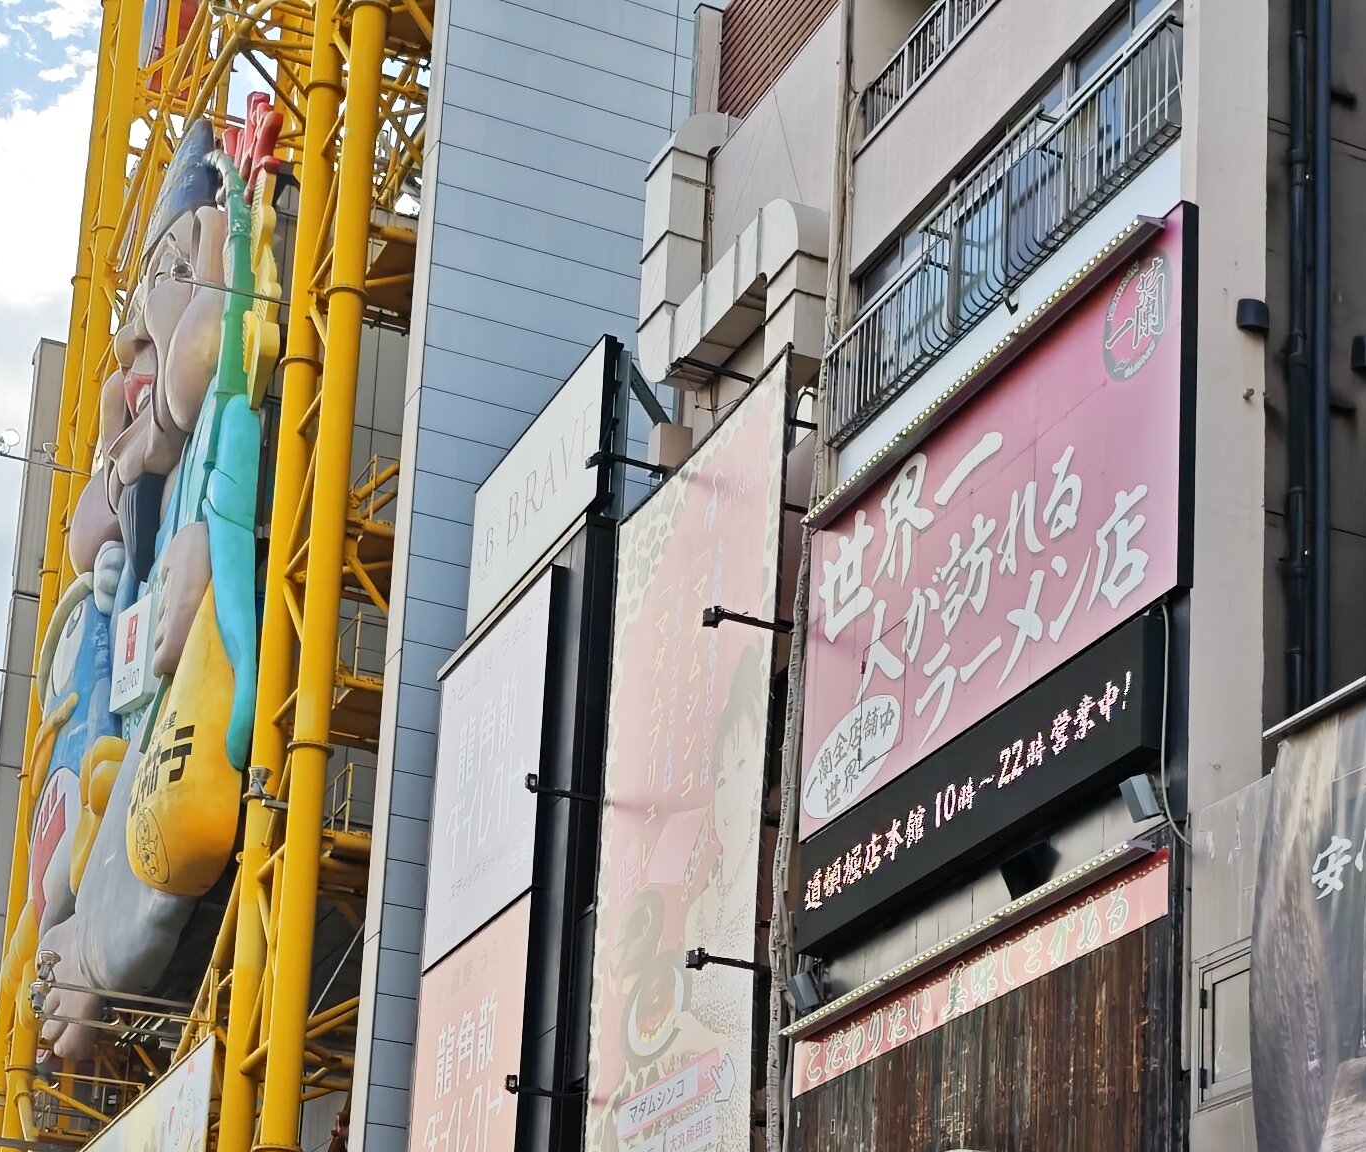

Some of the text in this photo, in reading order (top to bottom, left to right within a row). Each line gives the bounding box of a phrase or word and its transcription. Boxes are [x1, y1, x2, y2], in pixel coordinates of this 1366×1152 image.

[819, 431, 1004, 643] 世界一
[857, 445, 1084, 703] 人が訪れる
[915, 485, 1150, 749] ラーメン店
[457, 680, 517, 791] 龍角散
[804, 805, 927, 912] 道頓堀店本館
[434, 988, 498, 1101] 龍角散
[629, 1080, 685, 1124] マダムシンコ
